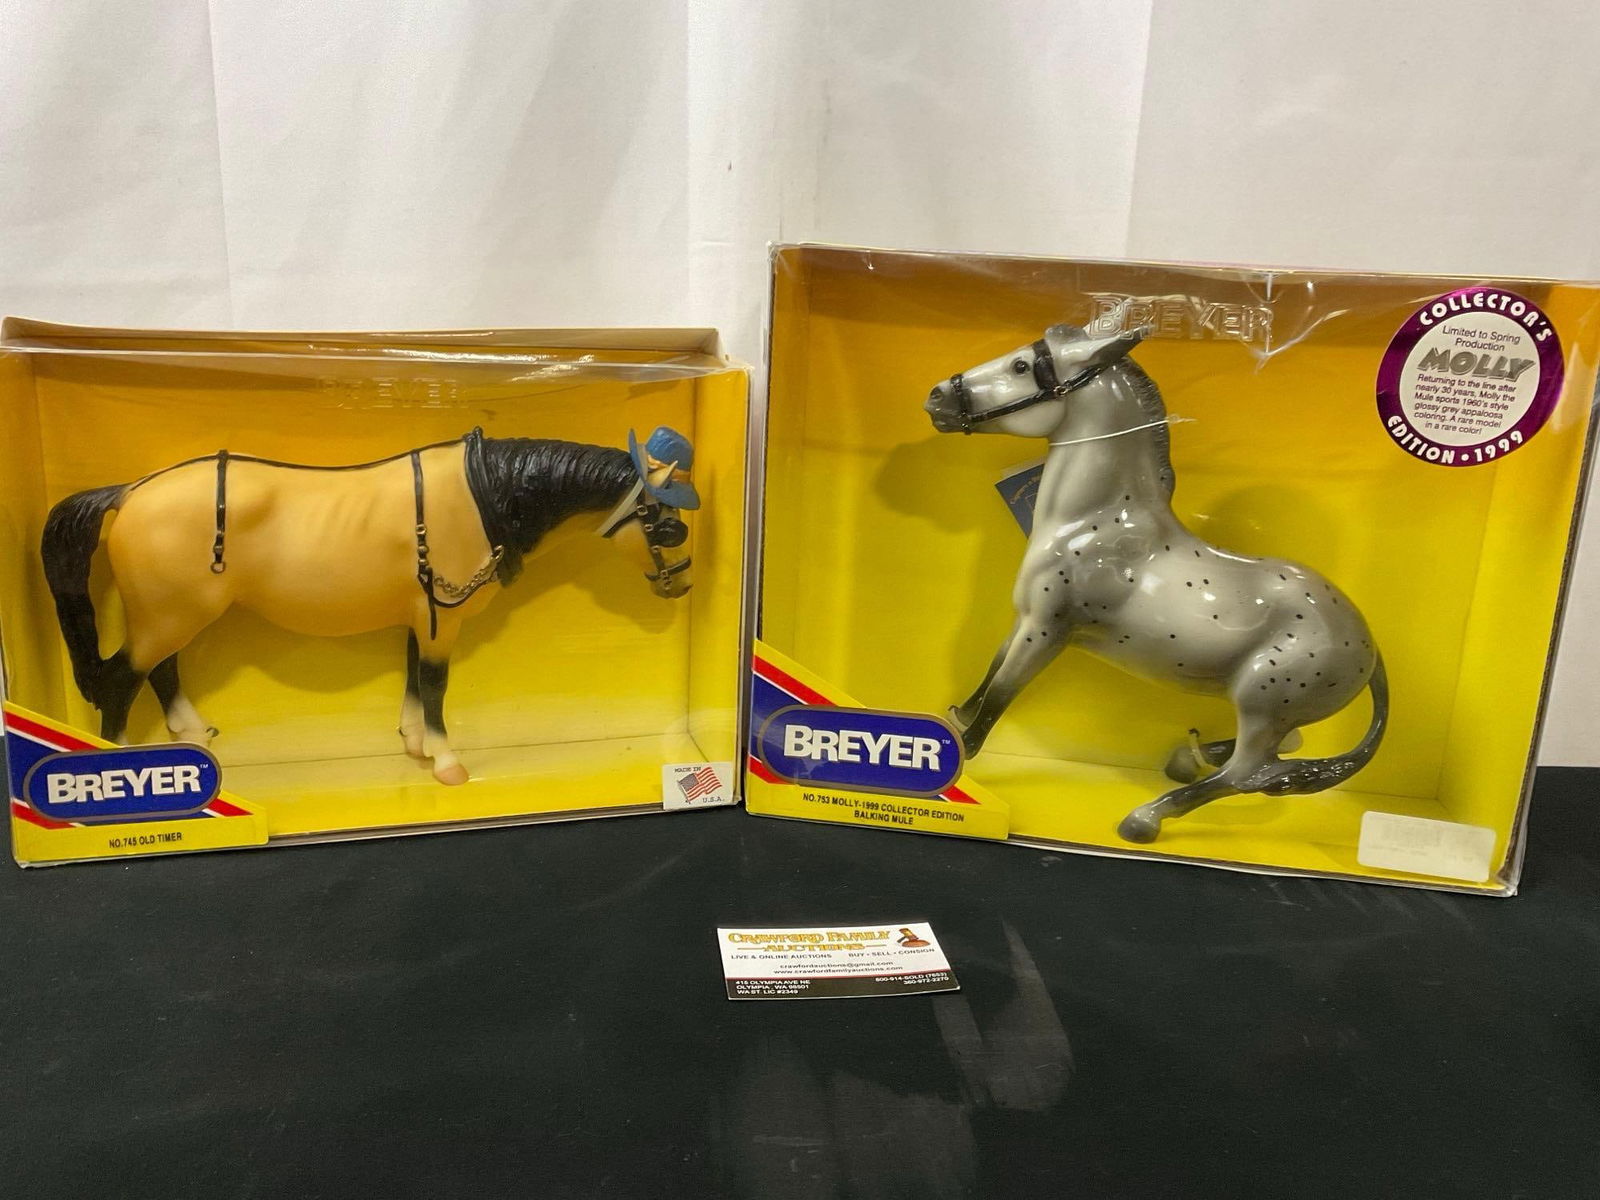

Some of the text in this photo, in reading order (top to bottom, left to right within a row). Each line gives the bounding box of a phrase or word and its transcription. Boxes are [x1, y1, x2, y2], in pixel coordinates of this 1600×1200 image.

[1419, 292, 1553, 342] COLLECTOR'S
[1443, 325, 1520, 345] Limited to Spring
[1455, 337, 1505, 351] Production
[1417, 347, 1536, 382] MOLLY
[1418, 374, 1456, 386] Returning
[1468, 379, 1480, 388] the
[1482, 381, 1496, 390] line
[1498, 384, 1516, 392] after
[1415, 392, 1509, 411] Mule sports 1960's style
[1416, 384, 1439, 394] nearly
[1442, 386, 1451, 394] 30
[1479, 391, 1500, 400] Molly
[1502, 393, 1515, 402] the
[1414, 402, 1503, 419] glossy grey appaloosa
[1442, 423, 1457, 431] rare
[1459, 426, 1482, 435] color!
[1476, 419, 1502, 428] model
[1387, 415, 1523, 464] EDITION 1999
[784, 724, 941, 772] BREYER
[47, 765, 201, 804] BREYER
[832, 796, 879, 811] MOLLY-1999
[881, 803, 929, 817] COLLECTOR
[931, 810, 964, 822] EDITION
[854, 810, 913, 825] BALKING MULE
[139, 835, 155, 845] OLD
[157, 832, 182, 842] TIMER
[728, 930, 891, 944] CRAWFORD FAMILY
[764, 943, 866, 951] AUCTIONS
